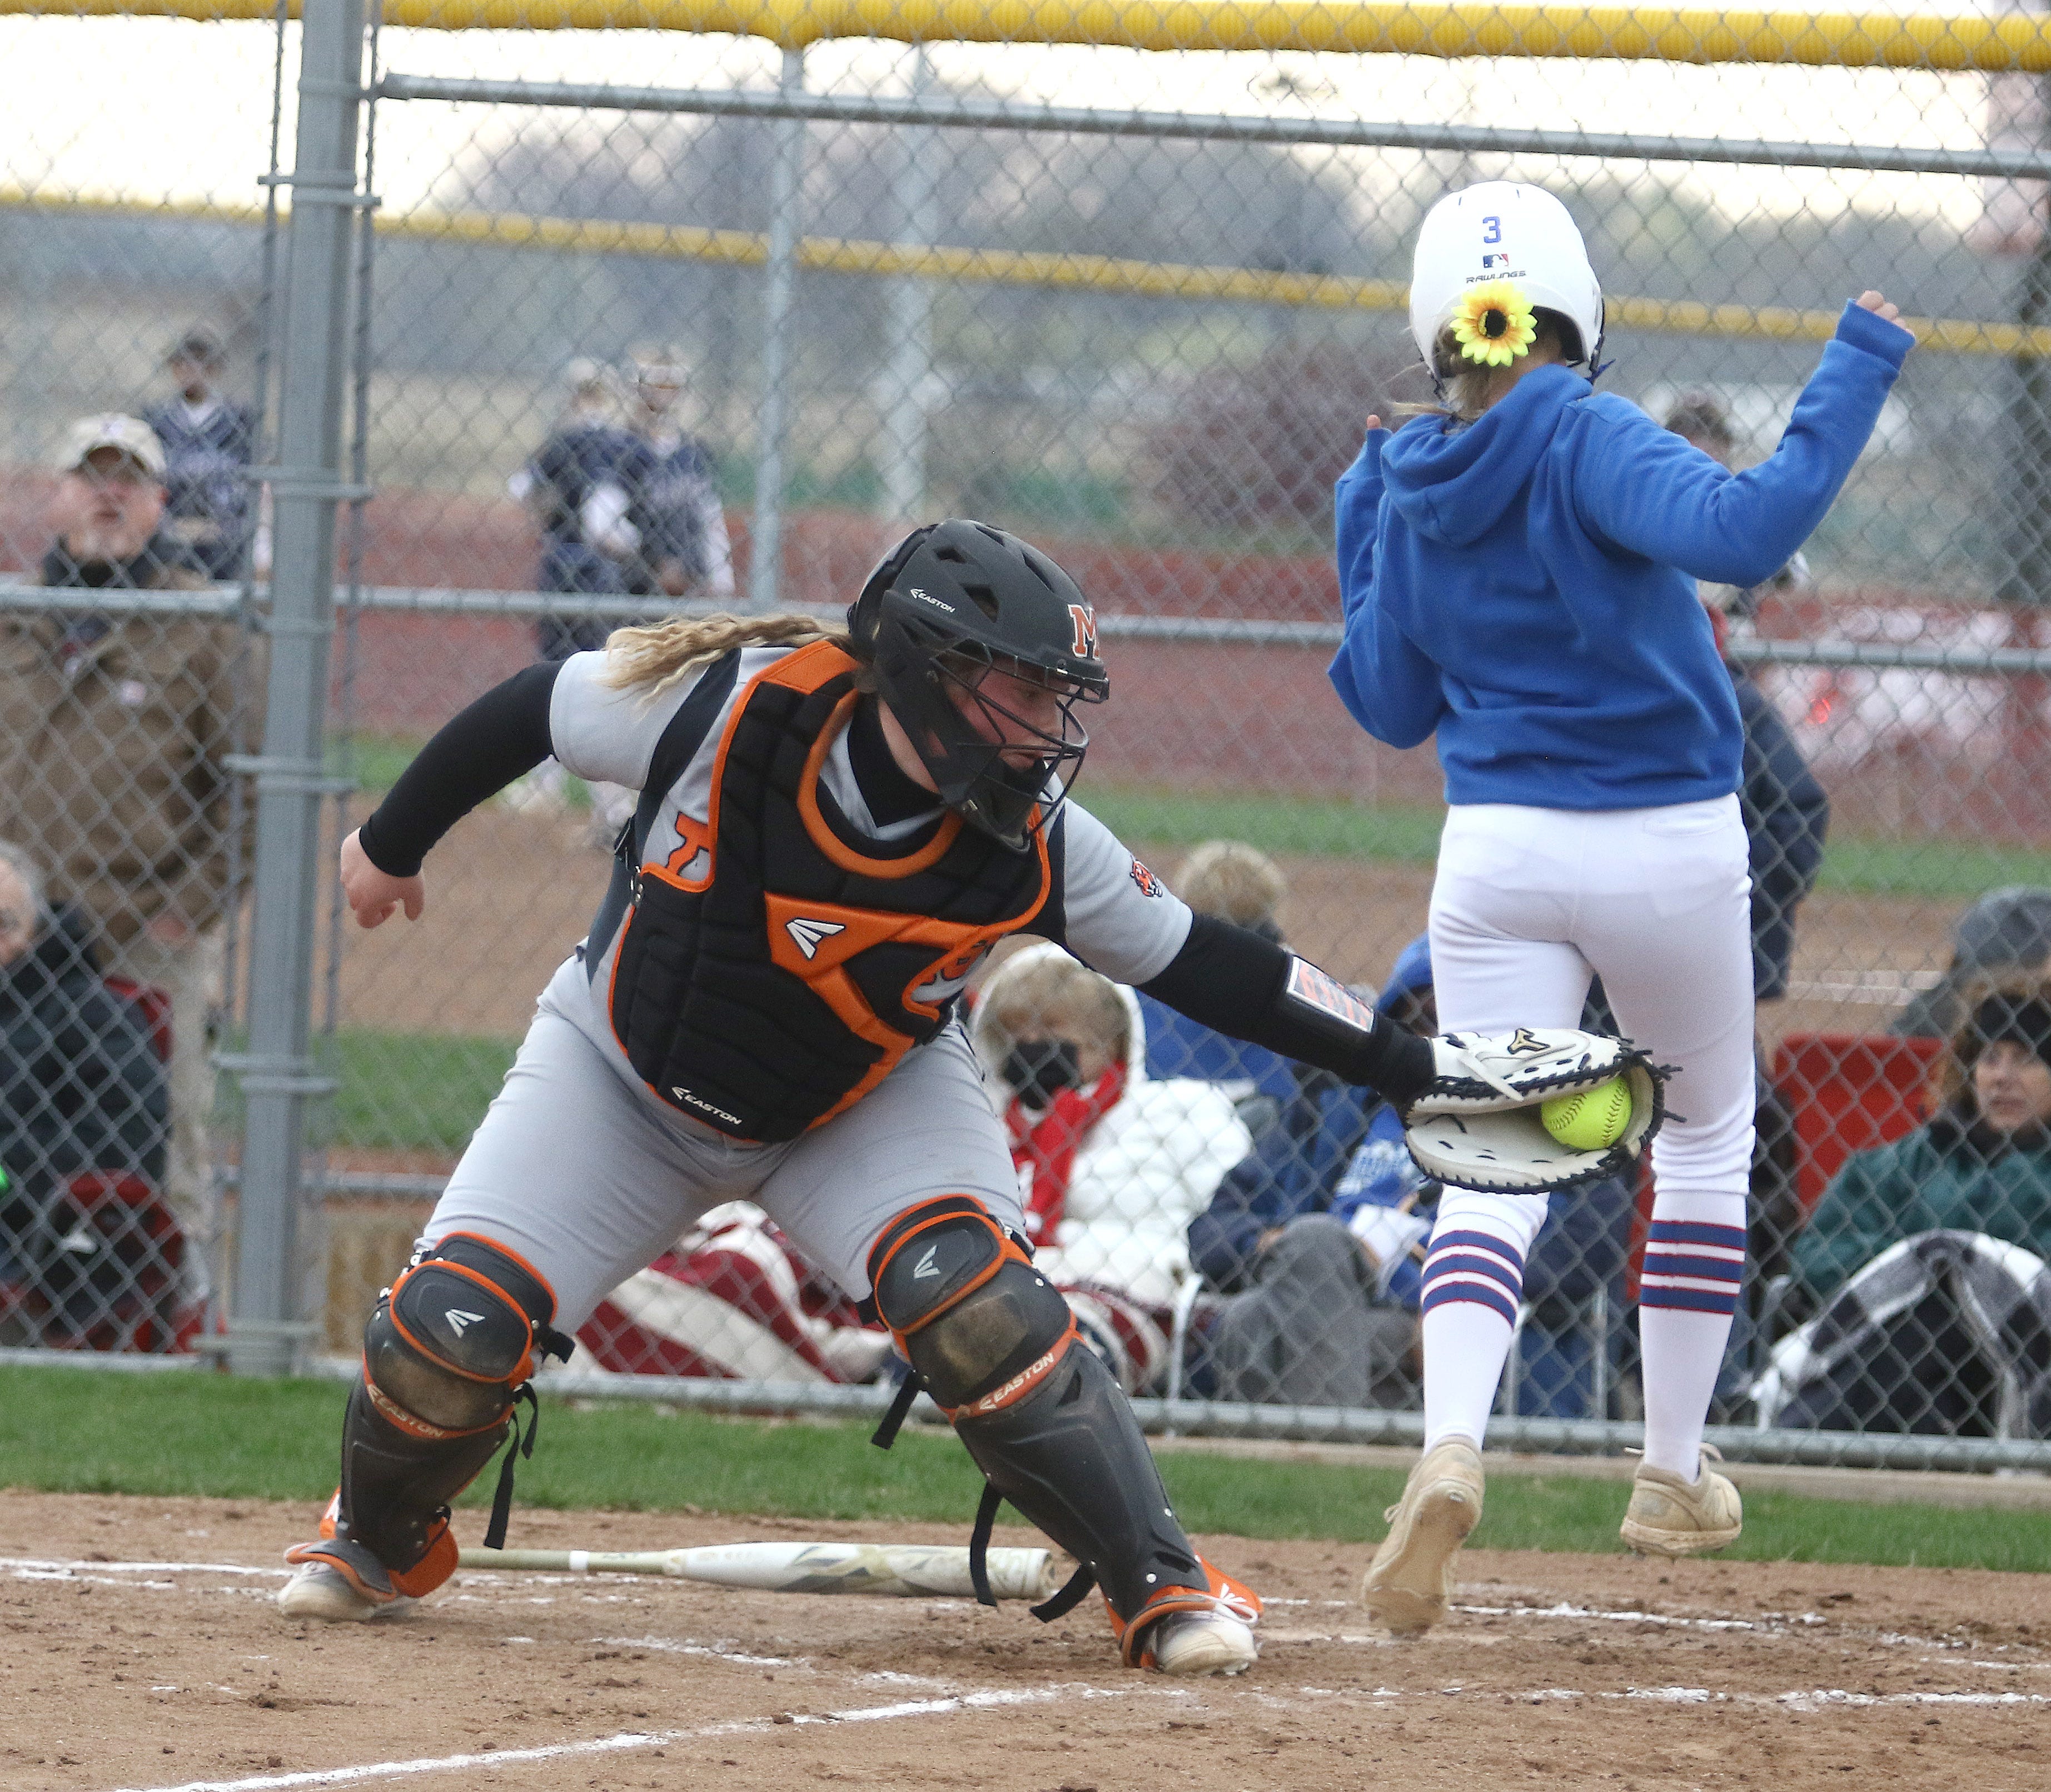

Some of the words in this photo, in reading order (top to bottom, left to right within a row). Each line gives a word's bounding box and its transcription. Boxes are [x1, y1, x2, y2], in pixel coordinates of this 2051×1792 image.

[1482, 216, 1501, 243] 3
[1466, 270, 1526, 283] RAWLINGS
[918, 592, 955, 613] EASTON
[1067, 604, 1101, 661] M
[684, 1094, 743, 1125] EASTON
[993, 1352, 1054, 1403] EASTON
